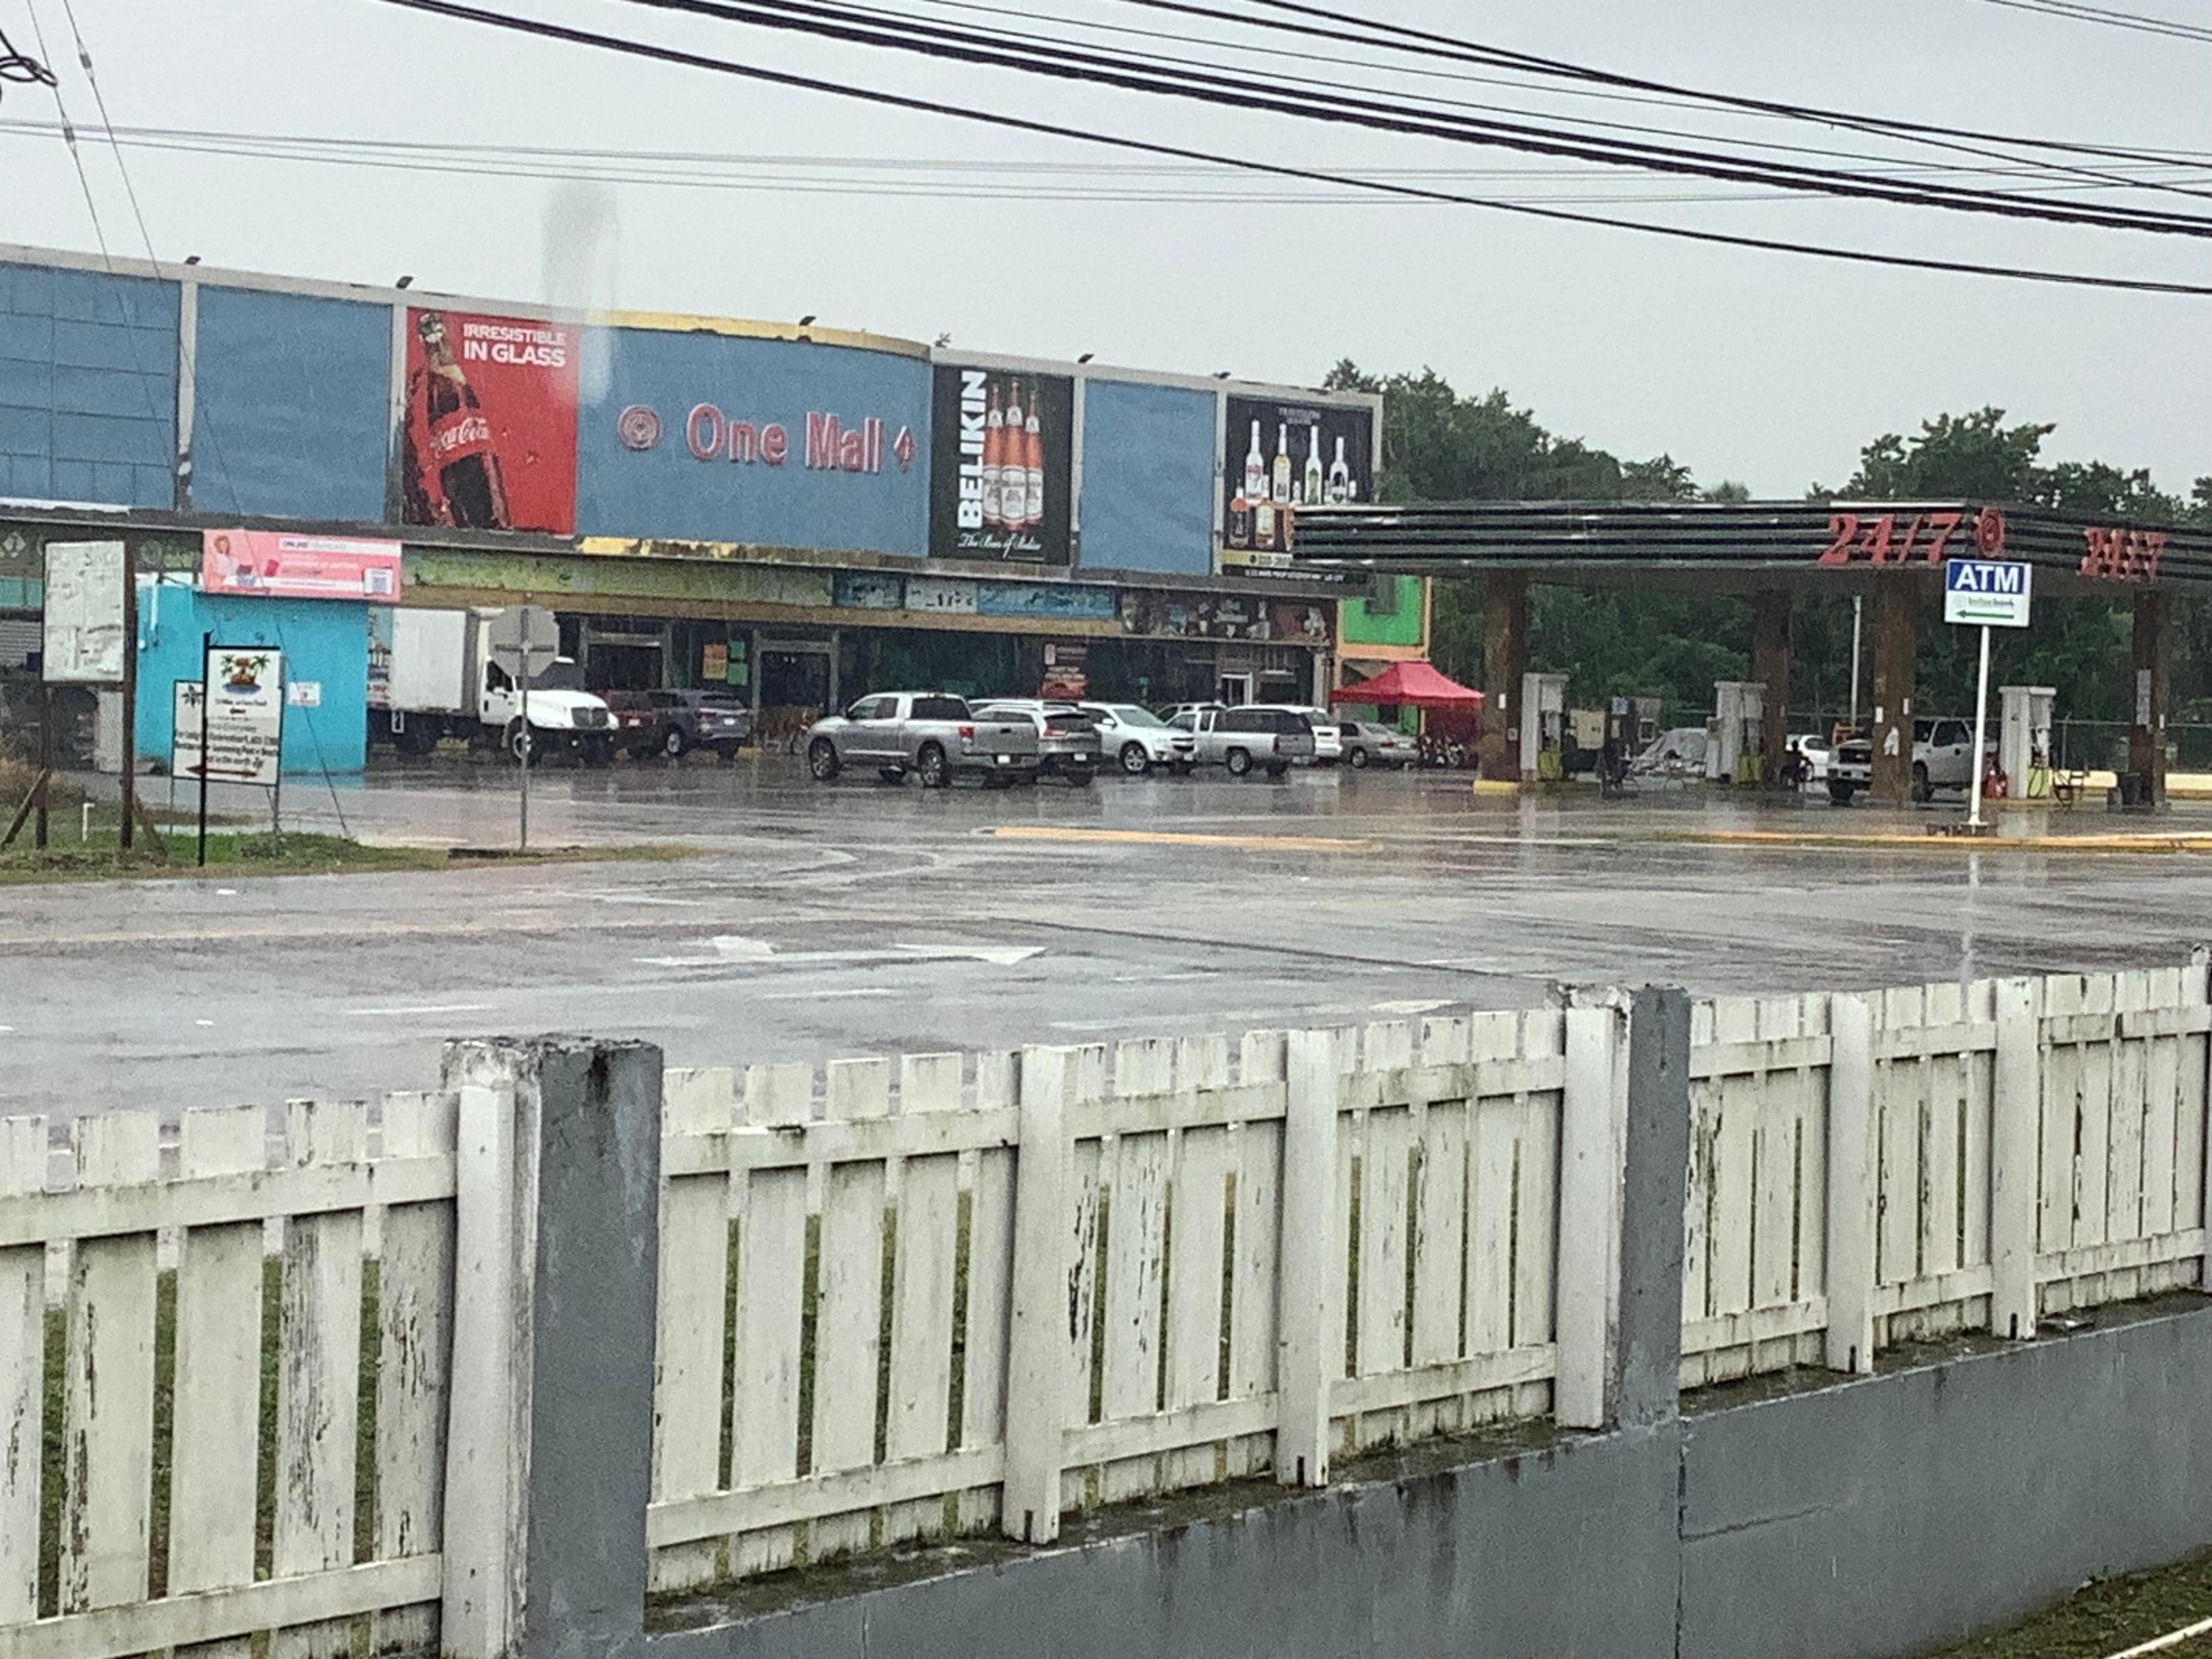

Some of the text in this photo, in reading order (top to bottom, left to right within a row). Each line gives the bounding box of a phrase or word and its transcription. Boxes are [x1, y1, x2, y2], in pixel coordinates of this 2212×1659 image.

[464, 323, 567, 346] IRRESISTIBLE
[464, 340, 566, 367] IN GLASS
[687, 403, 884, 474] One Mall
[957, 371, 987, 529] BELIKIN
[1816, 512, 1963, 566] 24/7
[1954, 563, 2020, 593] ATM
